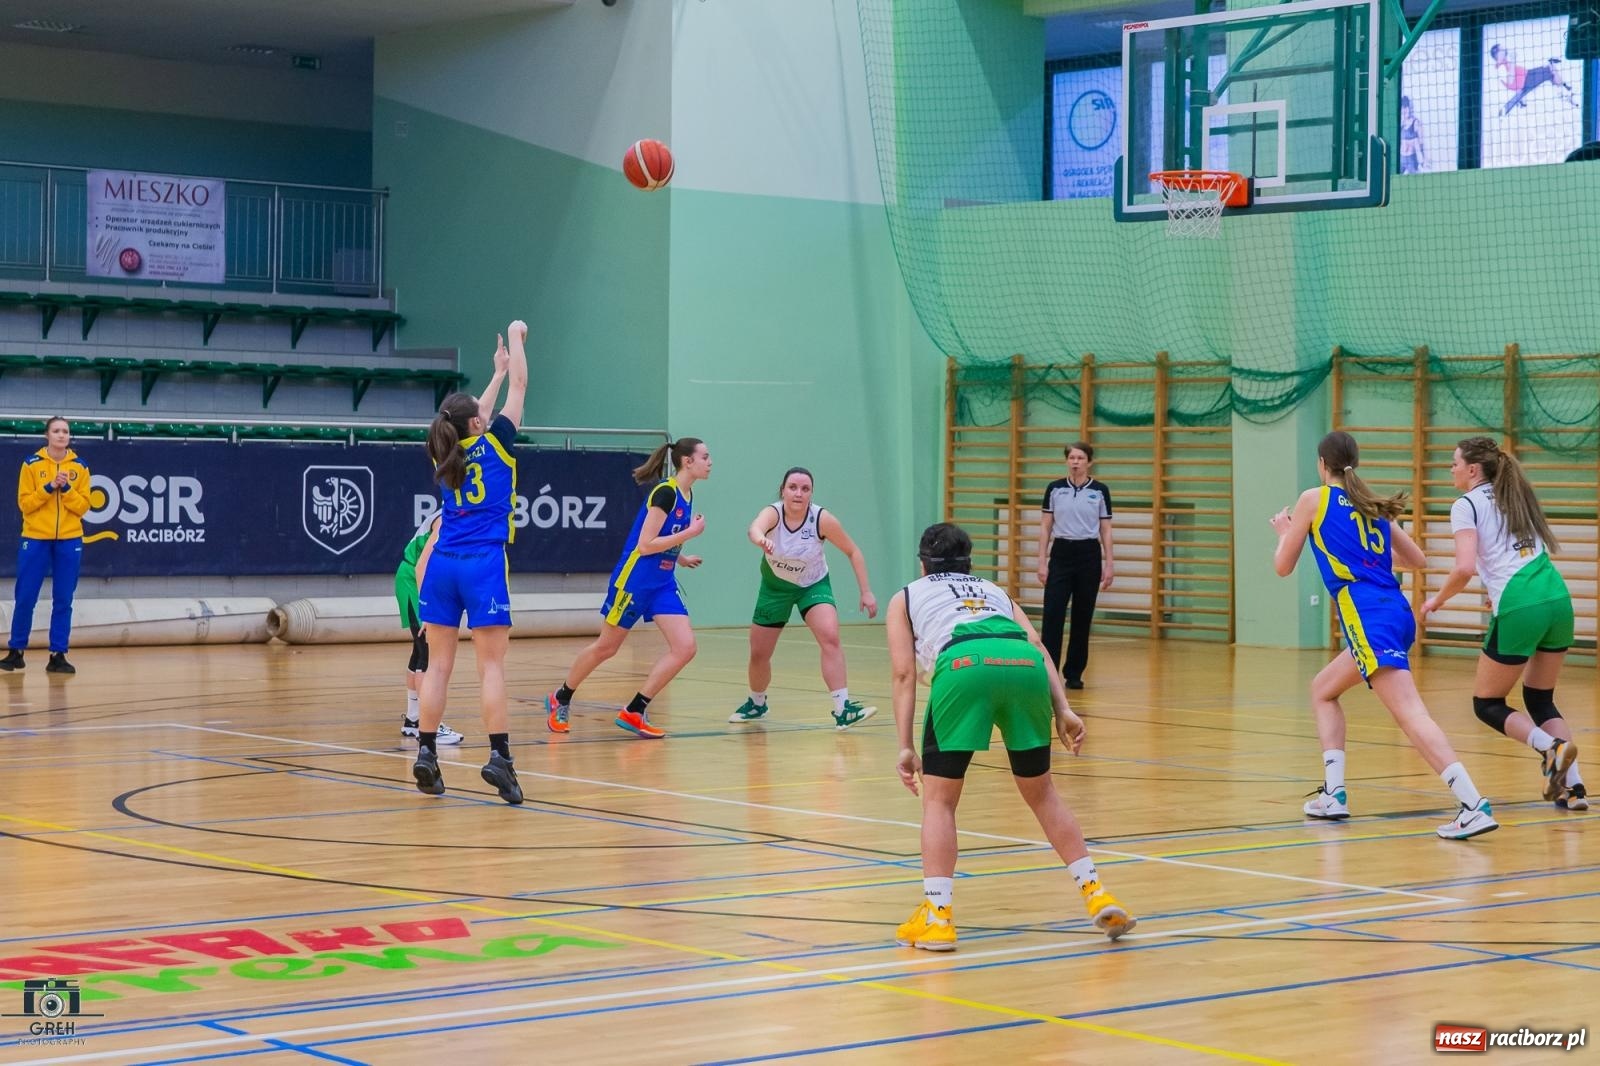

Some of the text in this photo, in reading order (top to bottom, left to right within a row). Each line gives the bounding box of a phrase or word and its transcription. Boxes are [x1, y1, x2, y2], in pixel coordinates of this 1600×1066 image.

[104, 178, 209, 206] MIESZKO
[105, 215, 221, 230] Operator urządzeń cukierniczych
[105, 223, 188, 237] Pracownik produkcyjny
[148, 240, 179, 250] Czekamy
[192, 242, 215, 250] Ciebie!
[414, 483, 607, 529] RBÓRZ
[127, 525, 205, 543] RACIBÓRZ
[1350, 511, 1385, 555] 15
